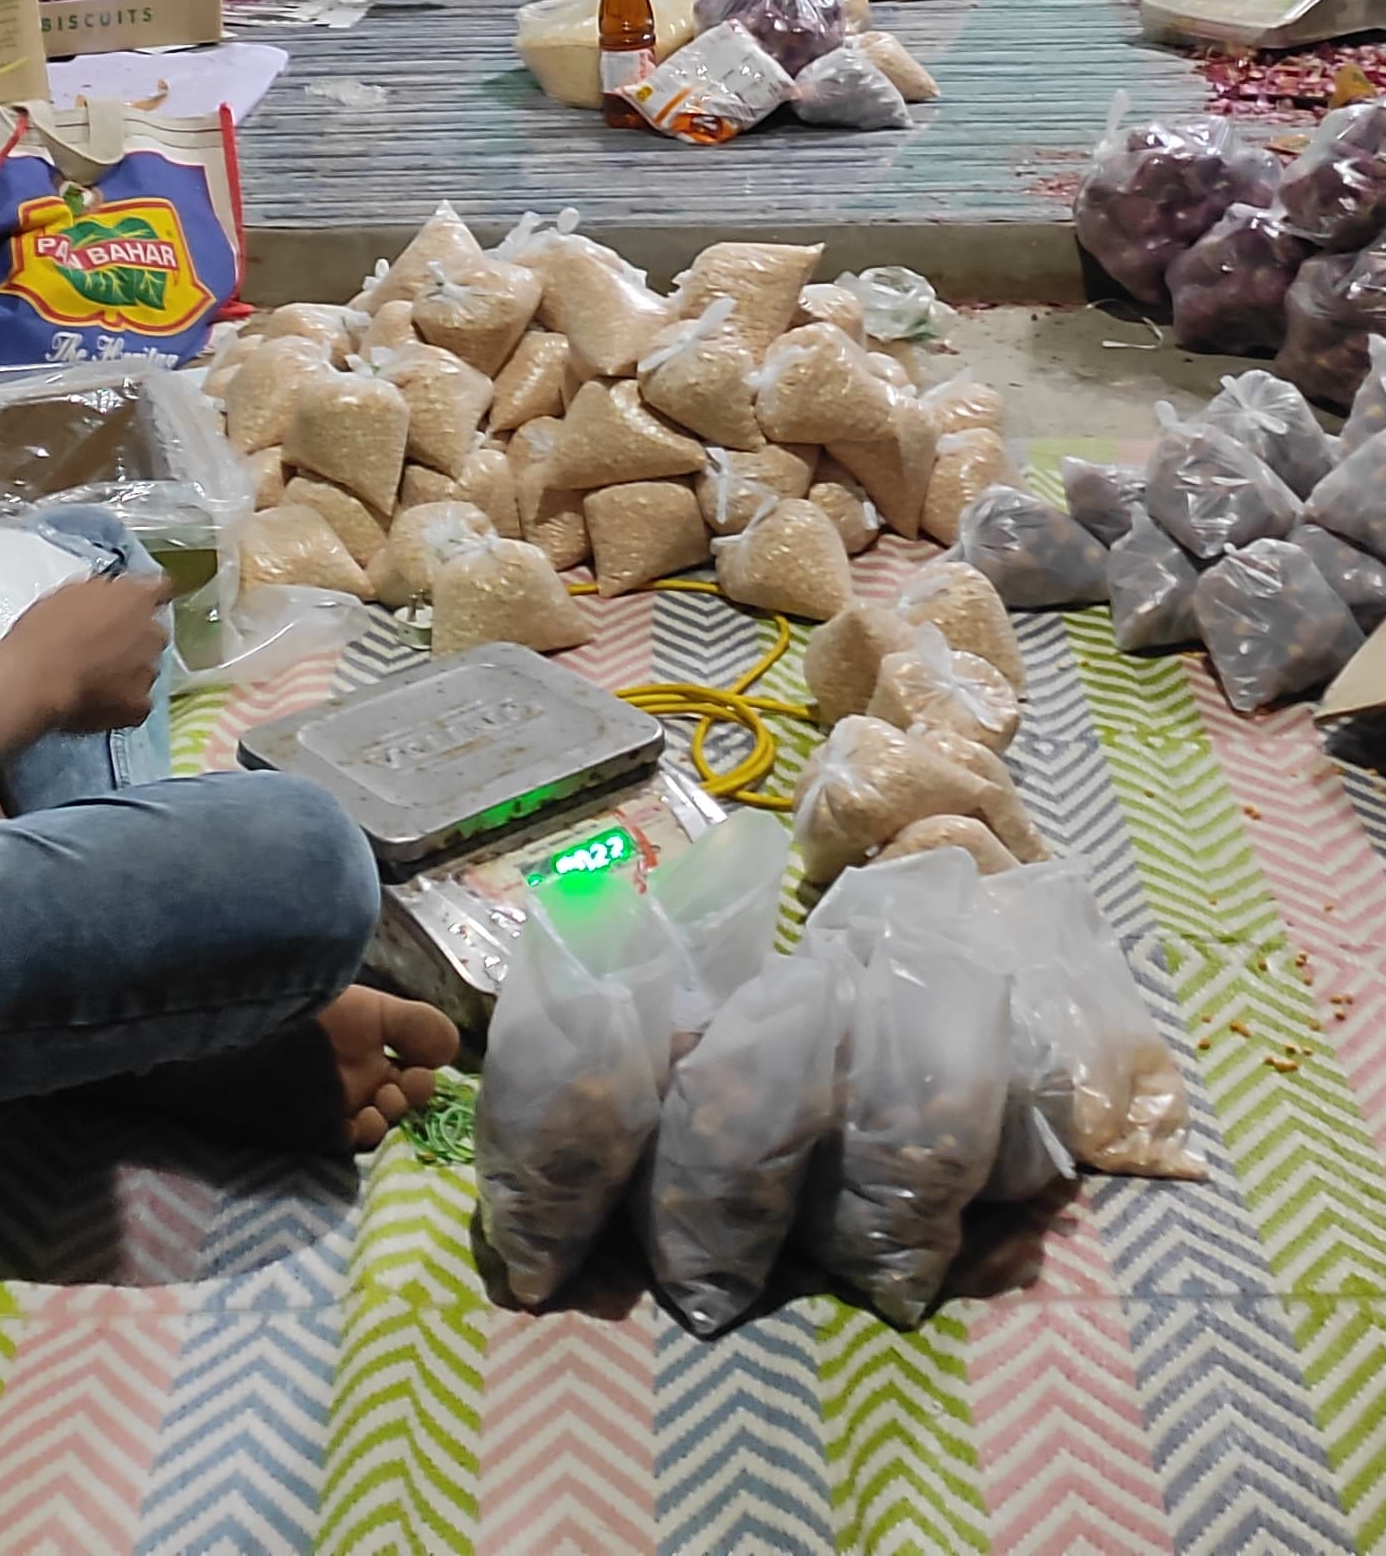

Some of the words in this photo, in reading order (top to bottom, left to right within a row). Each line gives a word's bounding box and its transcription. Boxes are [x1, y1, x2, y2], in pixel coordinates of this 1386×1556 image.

[41, 8, 153, 32] BISCUITS
[86, 239, 177, 269] BAHAR
[44, 331, 88, 363] The
